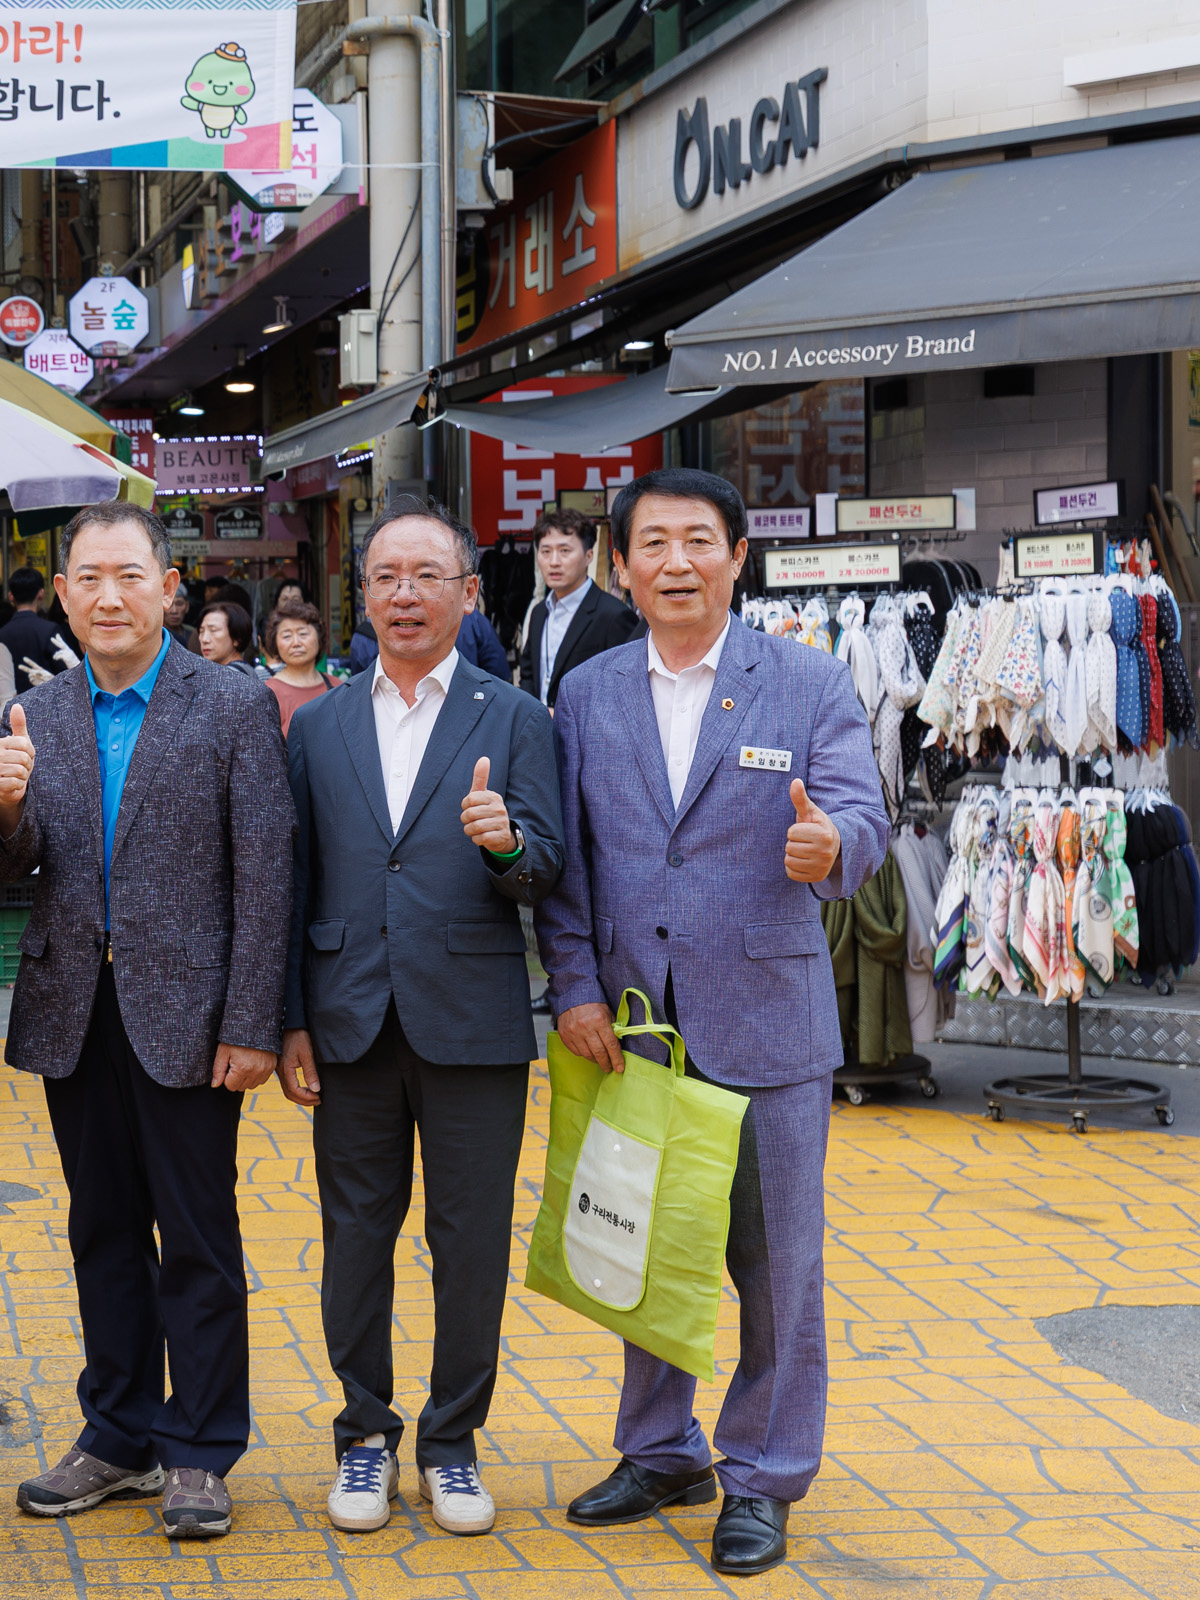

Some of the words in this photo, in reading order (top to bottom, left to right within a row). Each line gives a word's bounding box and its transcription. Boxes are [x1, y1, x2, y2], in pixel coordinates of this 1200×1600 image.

[100, 282, 116, 293] 2F
[81, 299, 138, 331] 놀숲
[721, 348, 778, 373] NO.1
[785, 343, 899, 369] Accessory
[905, 329, 976, 359] Brand
[29, 353, 88, 374] 배트맨
[1059, 491, 1097, 508] 패션두건
[869, 504, 922, 519] 패션두건
[775, 571, 789, 580] 2개
[839, 568, 852, 577] 2개
[591, 1203, 636, 1234] 구리전통시장
